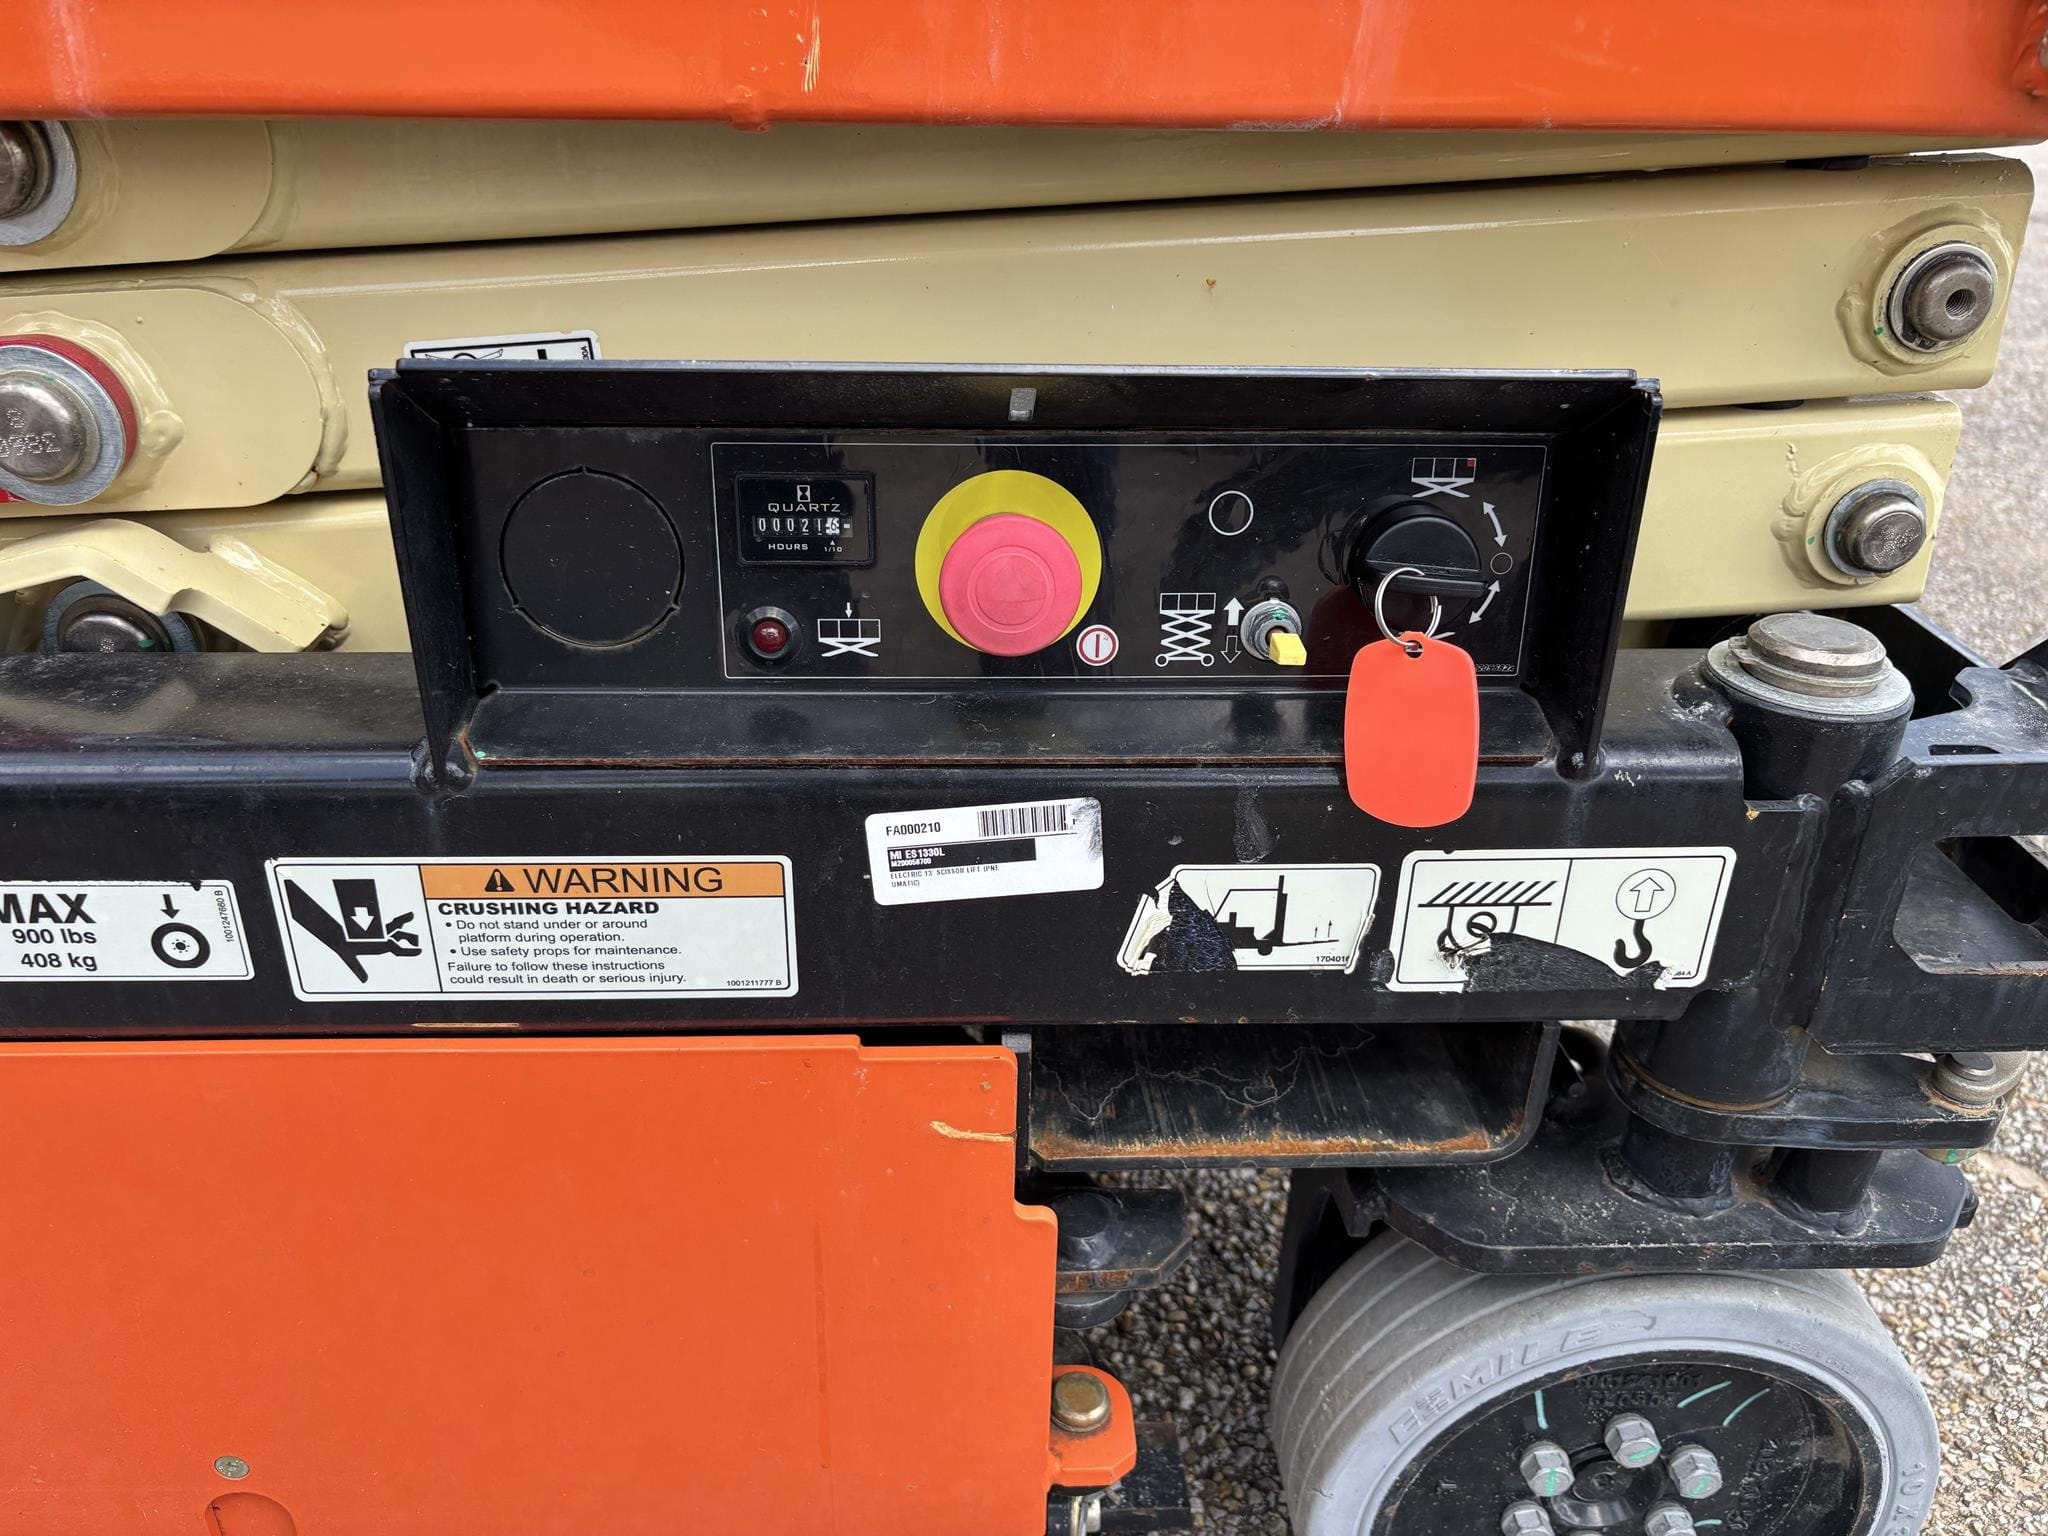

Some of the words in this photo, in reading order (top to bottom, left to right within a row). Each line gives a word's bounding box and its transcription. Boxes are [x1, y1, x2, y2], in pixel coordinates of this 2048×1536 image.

[768, 503, 841, 513] QUARTZ
[768, 543, 809, 551] HOURS
[885, 821, 941, 837] FA000210
[889, 850, 903, 860] MI
[890, 870, 923, 880] ELECTRIC
[936, 867, 965, 876] SCISSOR
[966, 865, 981, 874] LIFT
[522, 867, 723, 894] WARNING
[213, 889, 224, 897] B
[0, 893, 97, 924] MAX
[438, 902, 559, 915] CRUSHING
[566, 901, 660, 915] HAZARD
[456, 919, 476, 930] Do
[479, 919, 501, 930] not
[503, 919, 540, 930] stand
[543, 918, 580, 930] under
[585, 921, 599, 929] or
[602, 918, 648, 929] around
[11, 928, 55, 944] 900
[61, 927, 97, 944] lbs
[458, 932, 512, 944] platform
[515, 932, 556, 944] during
[559, 932, 625, 944] operation.
[460, 946, 487, 957] Use
[491, 945, 530, 958] safety
[533, 947, 570, 958] props
[574, 945, 591, 956] for
[594, 945, 682, 956] maintenance.
[20, 952, 62, 968] 408
[69, 952, 98, 972] kg
[448, 961, 492, 972] Failure
[495, 962, 508, 972] to
[511, 961, 549, 971] follow
[552, 961, 588, 971] these
[591, 960, 665, 971] instructions
[449, 974, 485, 984] could
[488, 974, 524, 984] result
[527, 974, 538, 984] in
[542, 973, 578, 983] death
[582, 975, 595, 983] or
[599, 973, 646, 983] serious
[649, 973, 687, 985] injury.
[726, 979, 774, 987] 1001211777
